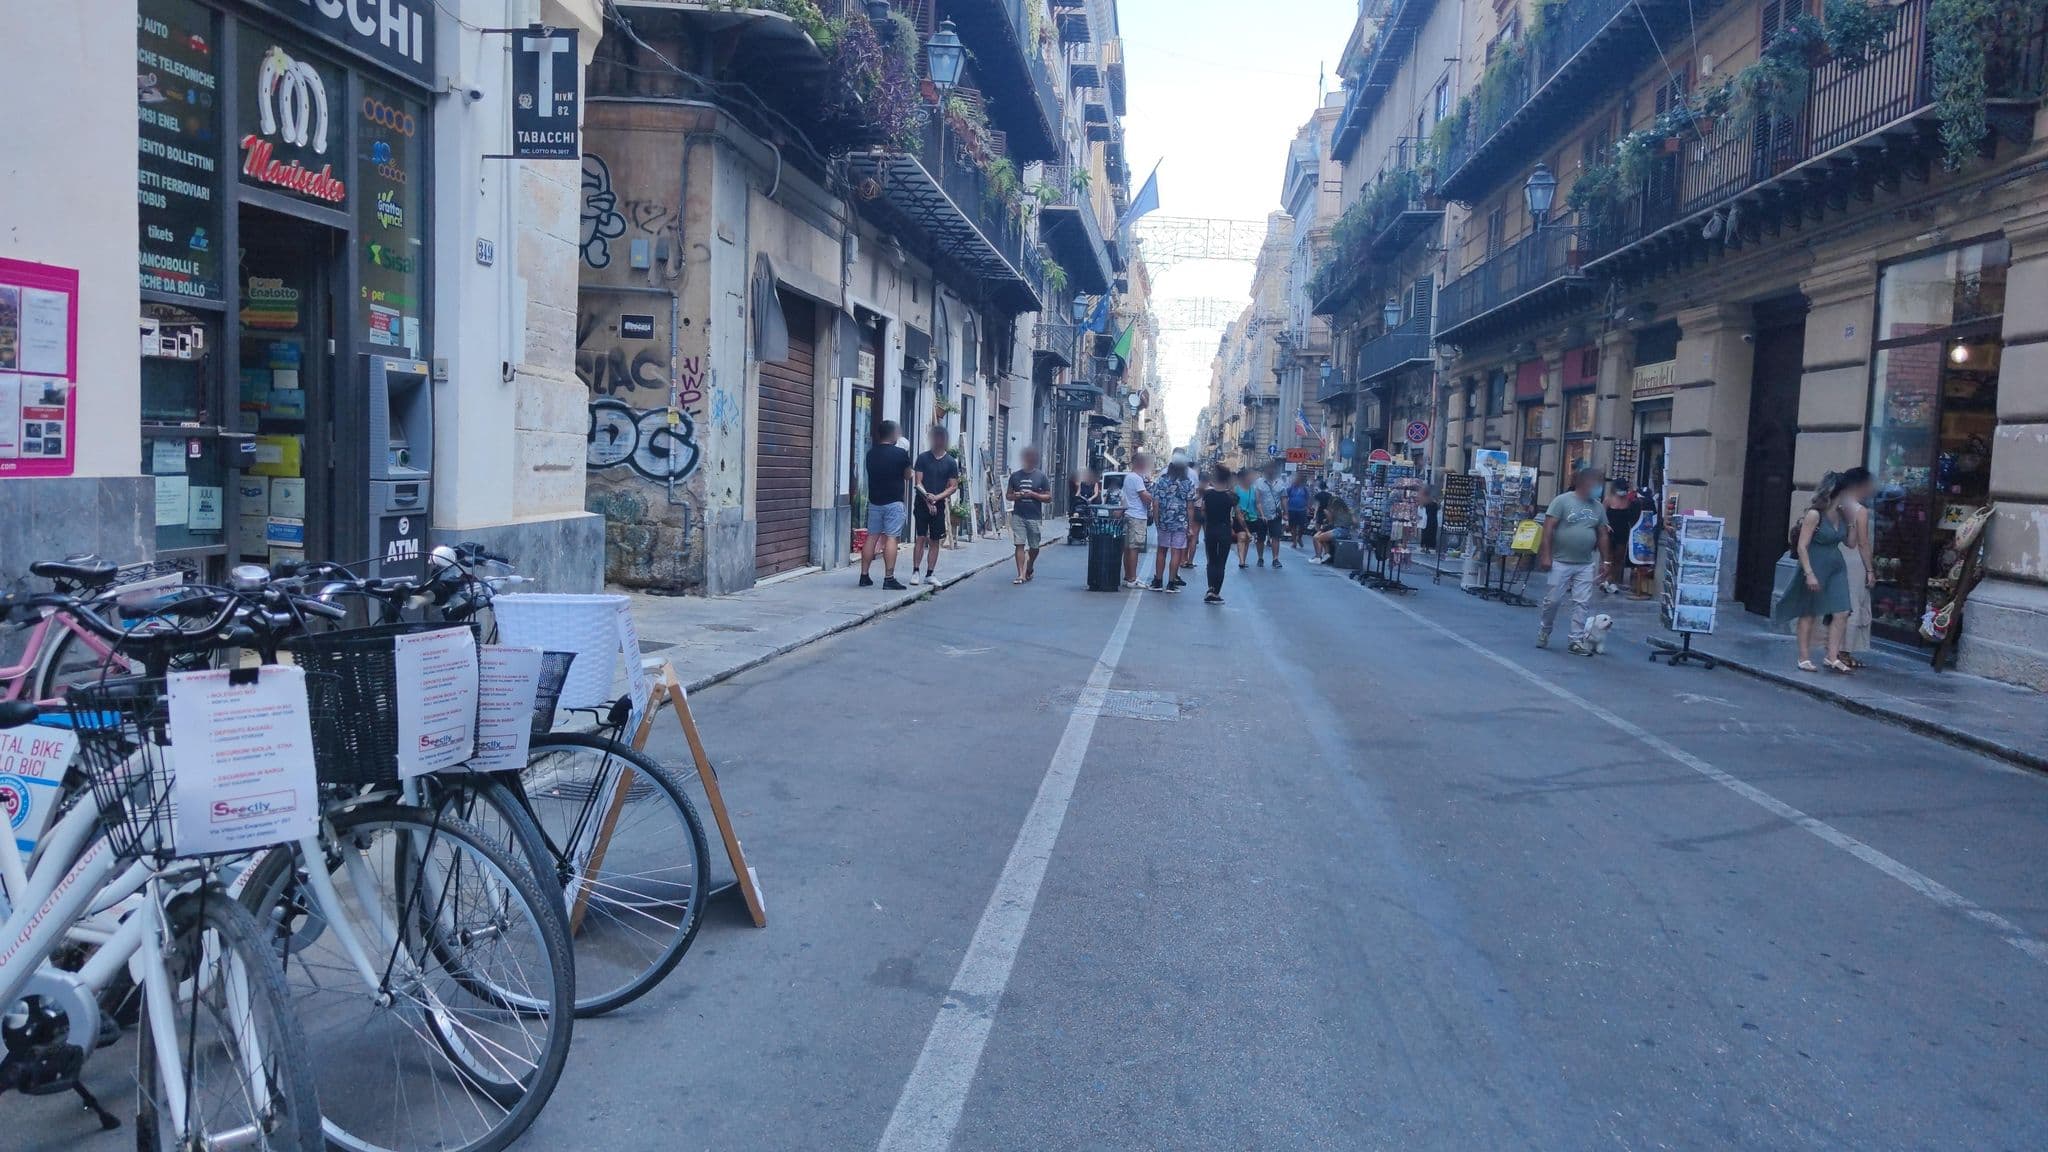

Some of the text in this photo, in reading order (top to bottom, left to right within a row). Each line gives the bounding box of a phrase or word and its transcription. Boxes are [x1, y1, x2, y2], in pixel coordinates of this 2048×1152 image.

[145, 18, 168, 38] AUTO
[158, 56, 215, 89] TELEFONICHE
[523, 37, 569, 117] T
[158, 113, 180, 132] ENEL
[517, 131, 575, 143] TABACCHI
[167, 145, 214, 172] BOLLETTINI
[161, 175, 210, 200] FERROVIARI
[163, 278, 176, 292] DA
[177, 281, 206, 297] BOLLO
[387, 538, 418, 562] ATM
[31, 739, 64, 760] BIKE
[19, 757, 46, 777] BICI
